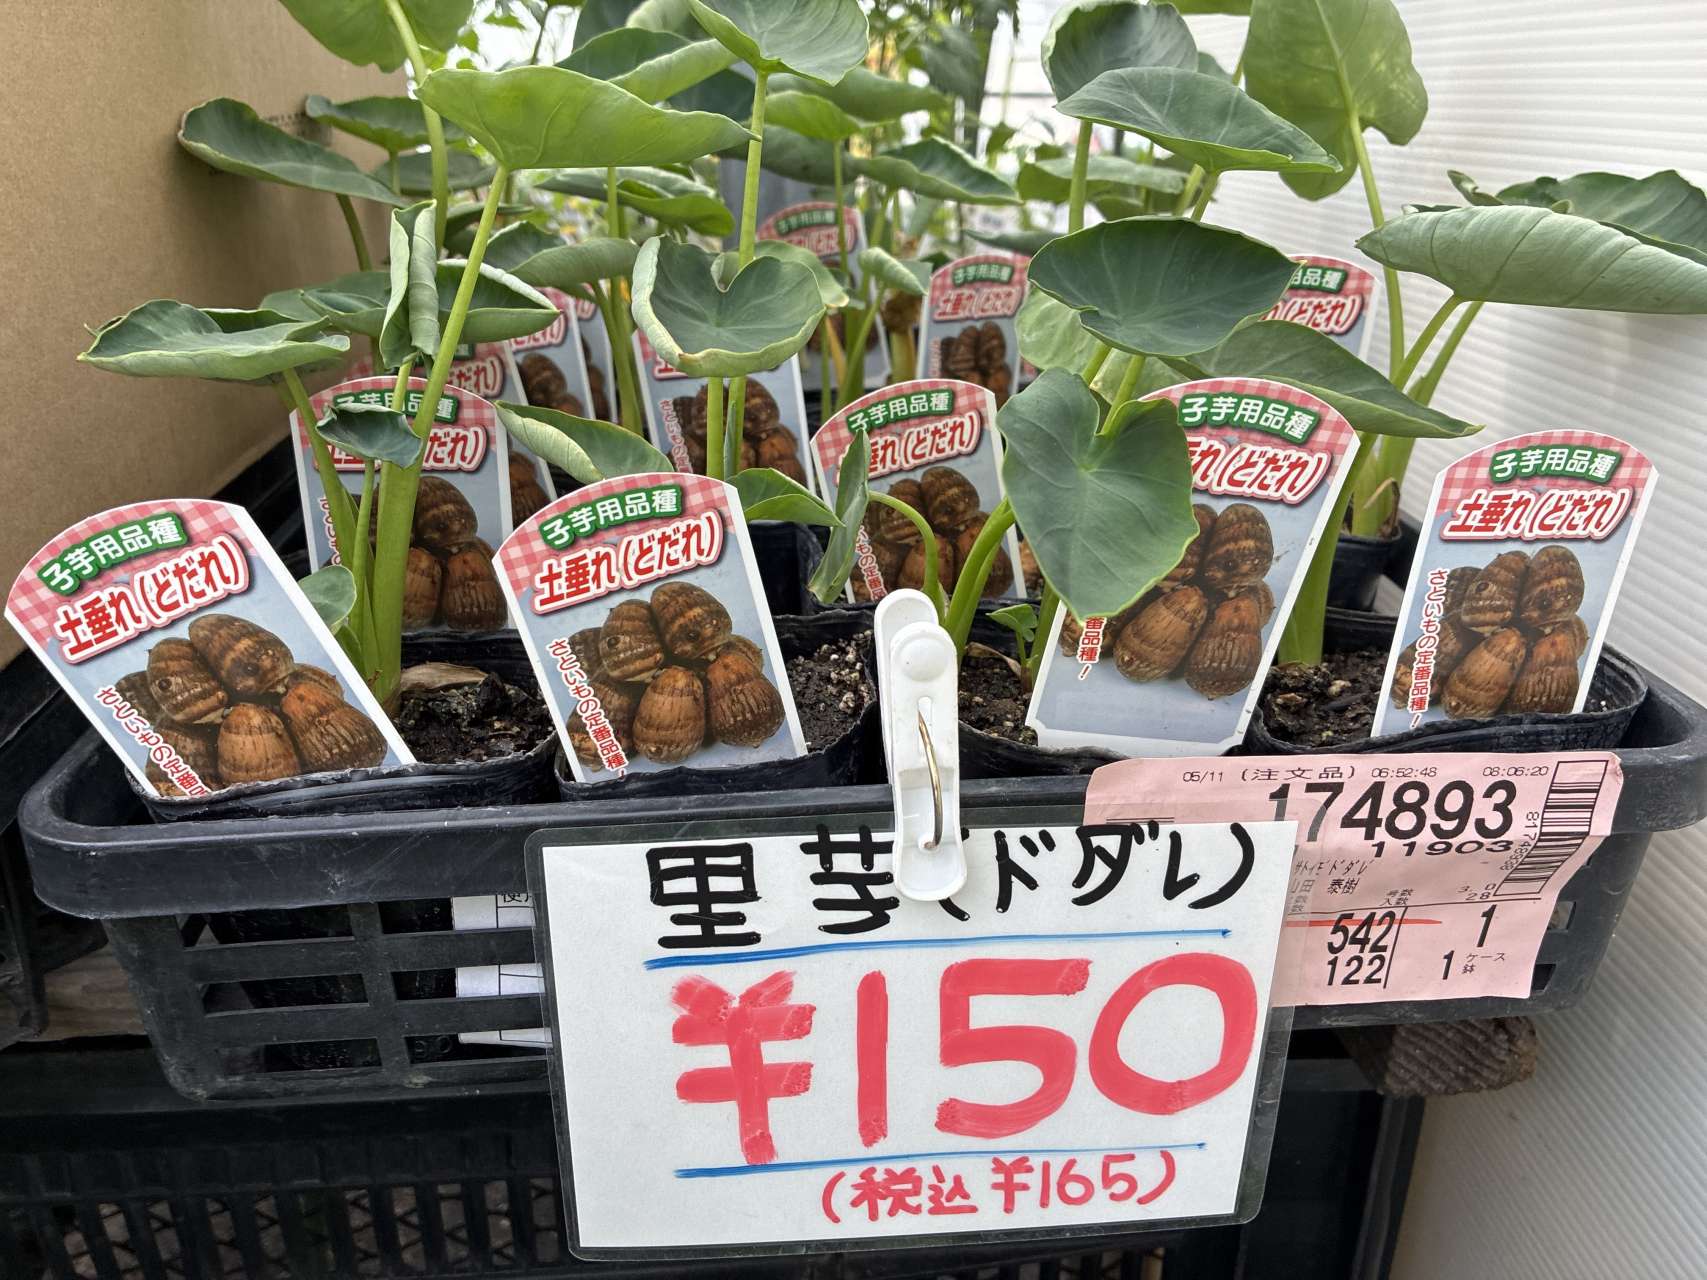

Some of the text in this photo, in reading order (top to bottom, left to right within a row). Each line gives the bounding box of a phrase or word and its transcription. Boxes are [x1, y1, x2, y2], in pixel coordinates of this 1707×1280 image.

[848, 392, 950, 431] 子芋用品種
[1181, 396, 1314, 439] 子芋用品種
[1492, 448, 1617, 480] 子芋用品種
[543, 488, 678, 546] 子芋用品種
[1449, 490, 1624, 535] 土垂れ(どだれ)
[42, 516, 182, 591] 子芋用品種
[538, 515, 716, 607] 土垂れ(どだれ)
[59, 539, 242, 657] 土垂れ(どだれ)
[1182, 765, 1549, 783] 05/11 (注文品) 06:52:48 08:06:20
[1267, 779, 1518, 843] 174893
[1371, 839, 1514, 858] 11903
[1326, 903, 1498, 954] 542 1
[1326, 949, 1455, 986] 122 1
[1465, 952, 1506, 963] ケース
[669, 951, 1258, 1165] ¥150
